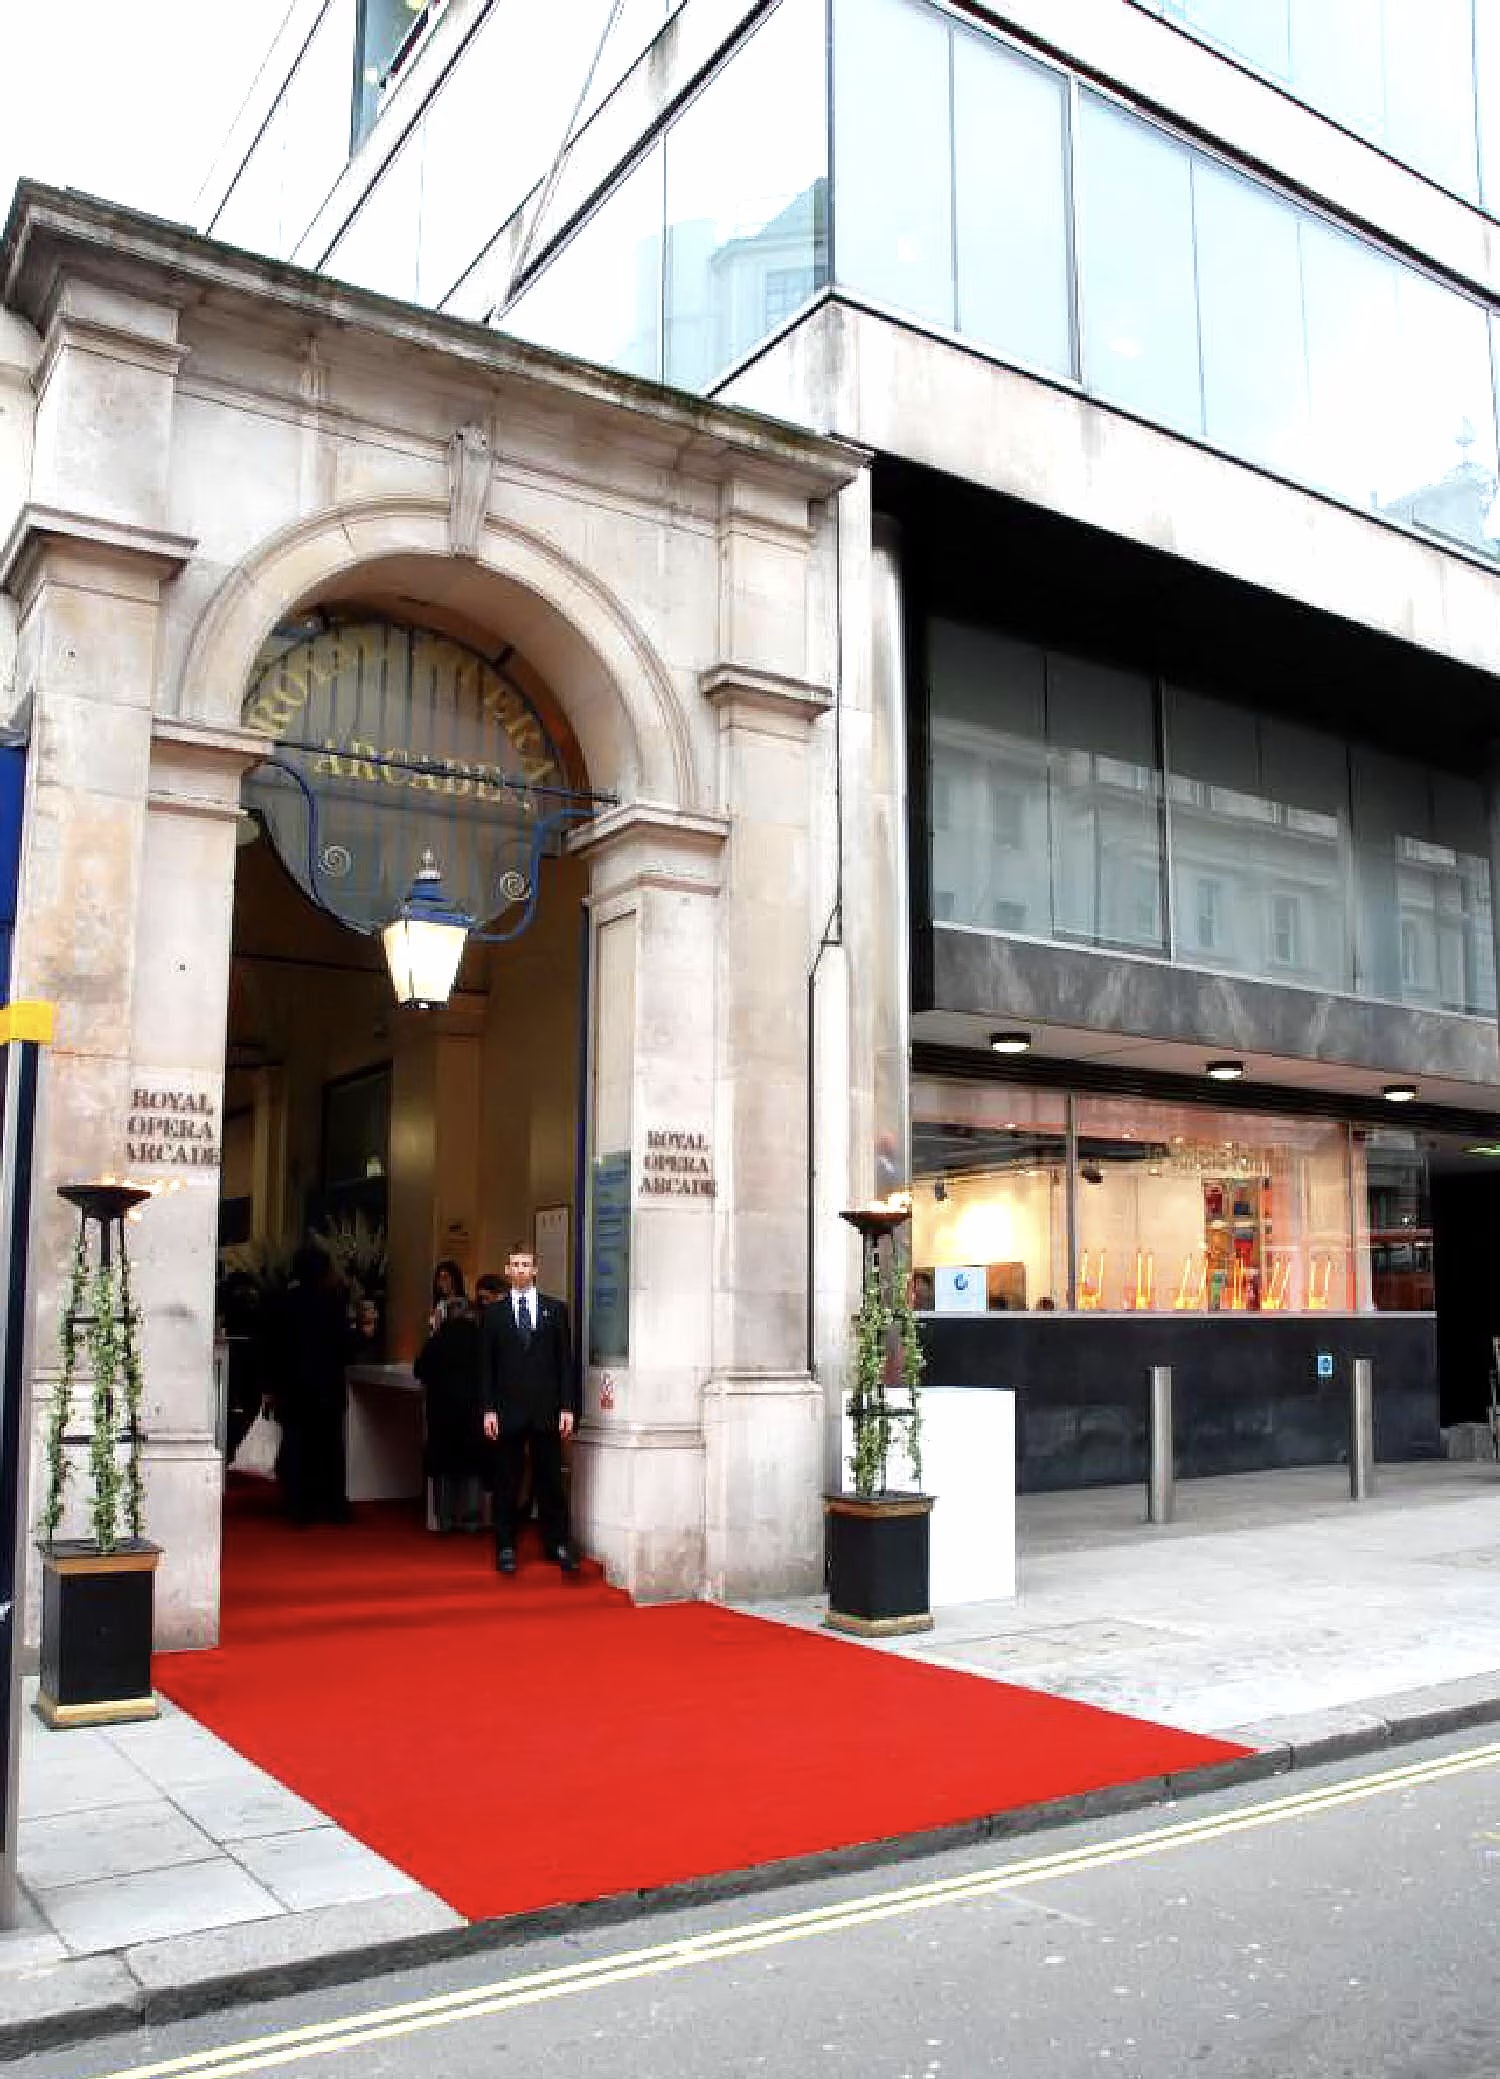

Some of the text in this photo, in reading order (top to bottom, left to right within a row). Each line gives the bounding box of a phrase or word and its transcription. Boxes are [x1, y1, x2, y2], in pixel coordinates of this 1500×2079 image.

[314, 735, 505, 801] ARCADE
[131, 1088, 214, 1115] ROYAL
[128, 1116, 213, 1140] OPERA
[646, 1130, 710, 1152] ROYAL
[126, 1142, 222, 1167] ARCADE
[643, 1153, 709, 1173] OPERA
[639, 1177, 715, 1197] ARCADE
